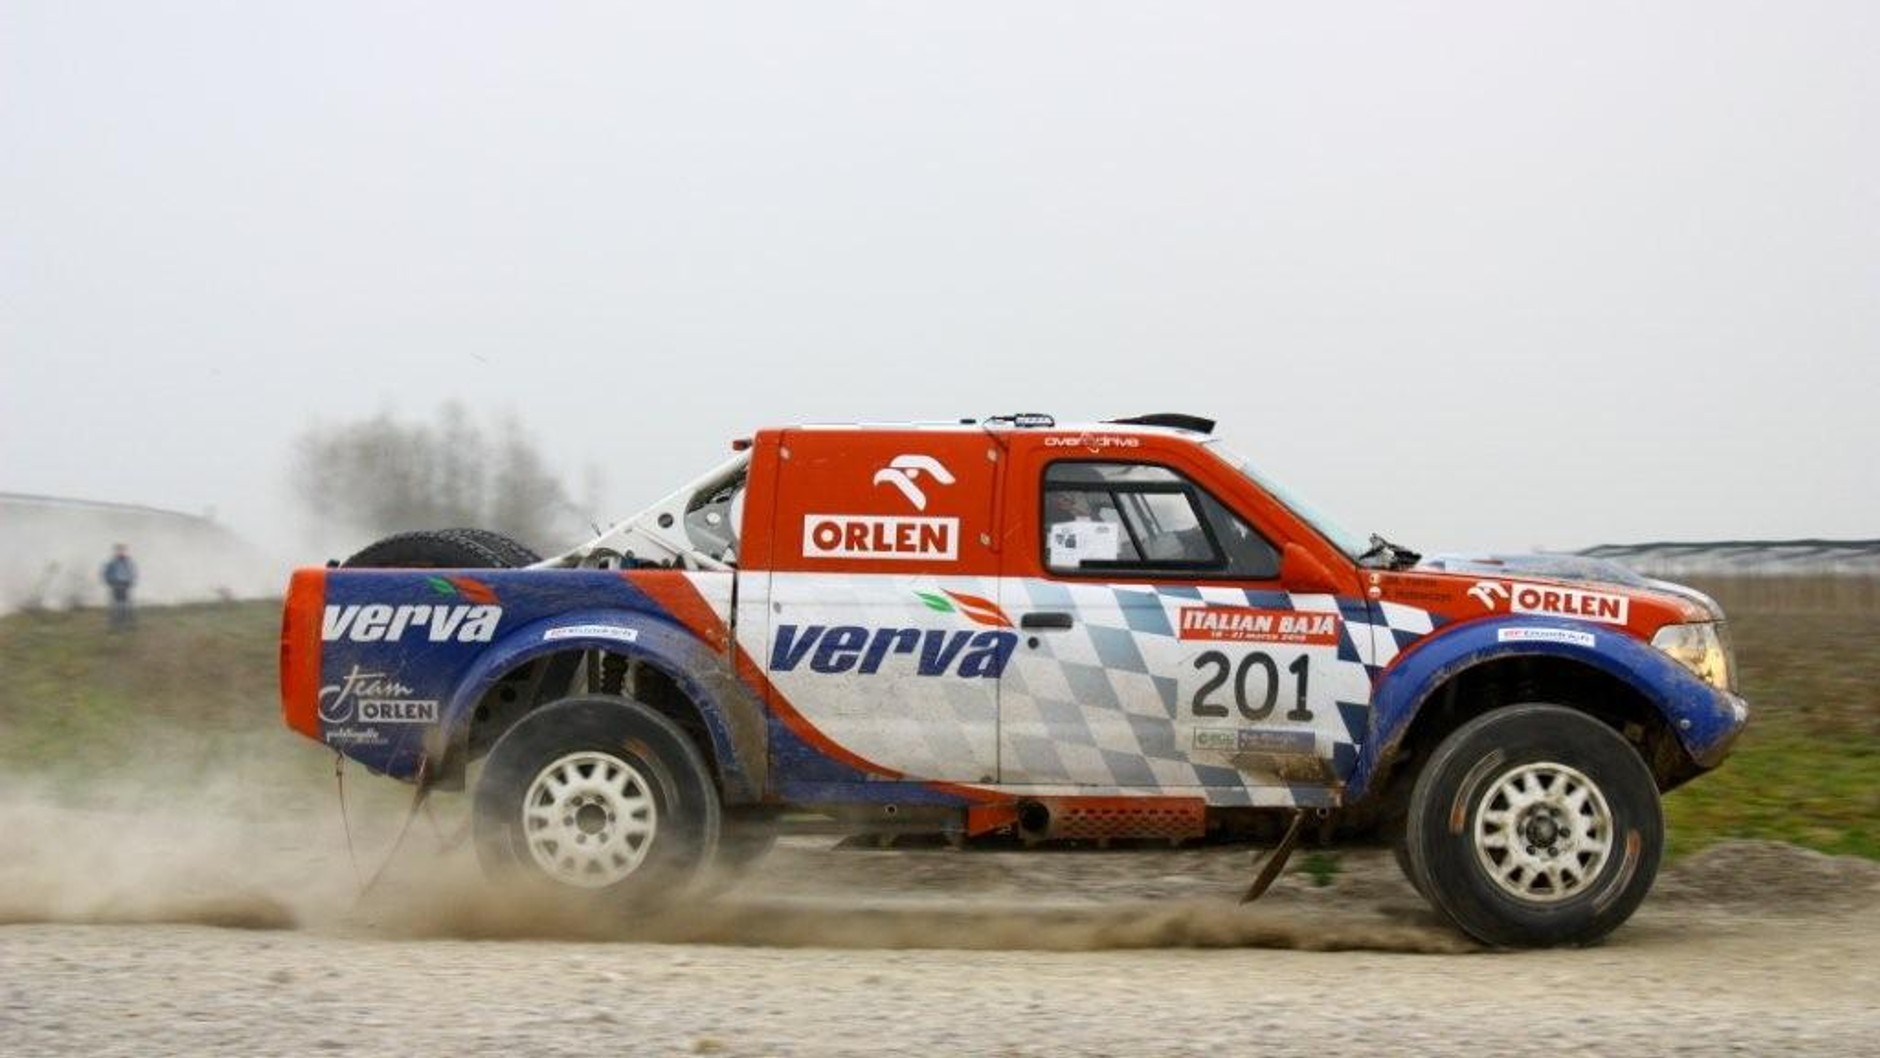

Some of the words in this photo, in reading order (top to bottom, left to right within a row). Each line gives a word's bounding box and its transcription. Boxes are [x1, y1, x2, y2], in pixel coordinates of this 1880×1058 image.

[812, 521, 949, 554] ORLEN
[1518, 588, 1621, 619] ORLEN
[321, 603, 503, 643] verva
[1183, 609, 1274, 632] ITALIAN
[1278, 614, 1336, 635] BAJA
[768, 624, 1019, 679] verva
[1192, 650, 1314, 721] 201
[363, 703, 433, 719] ORLEN
